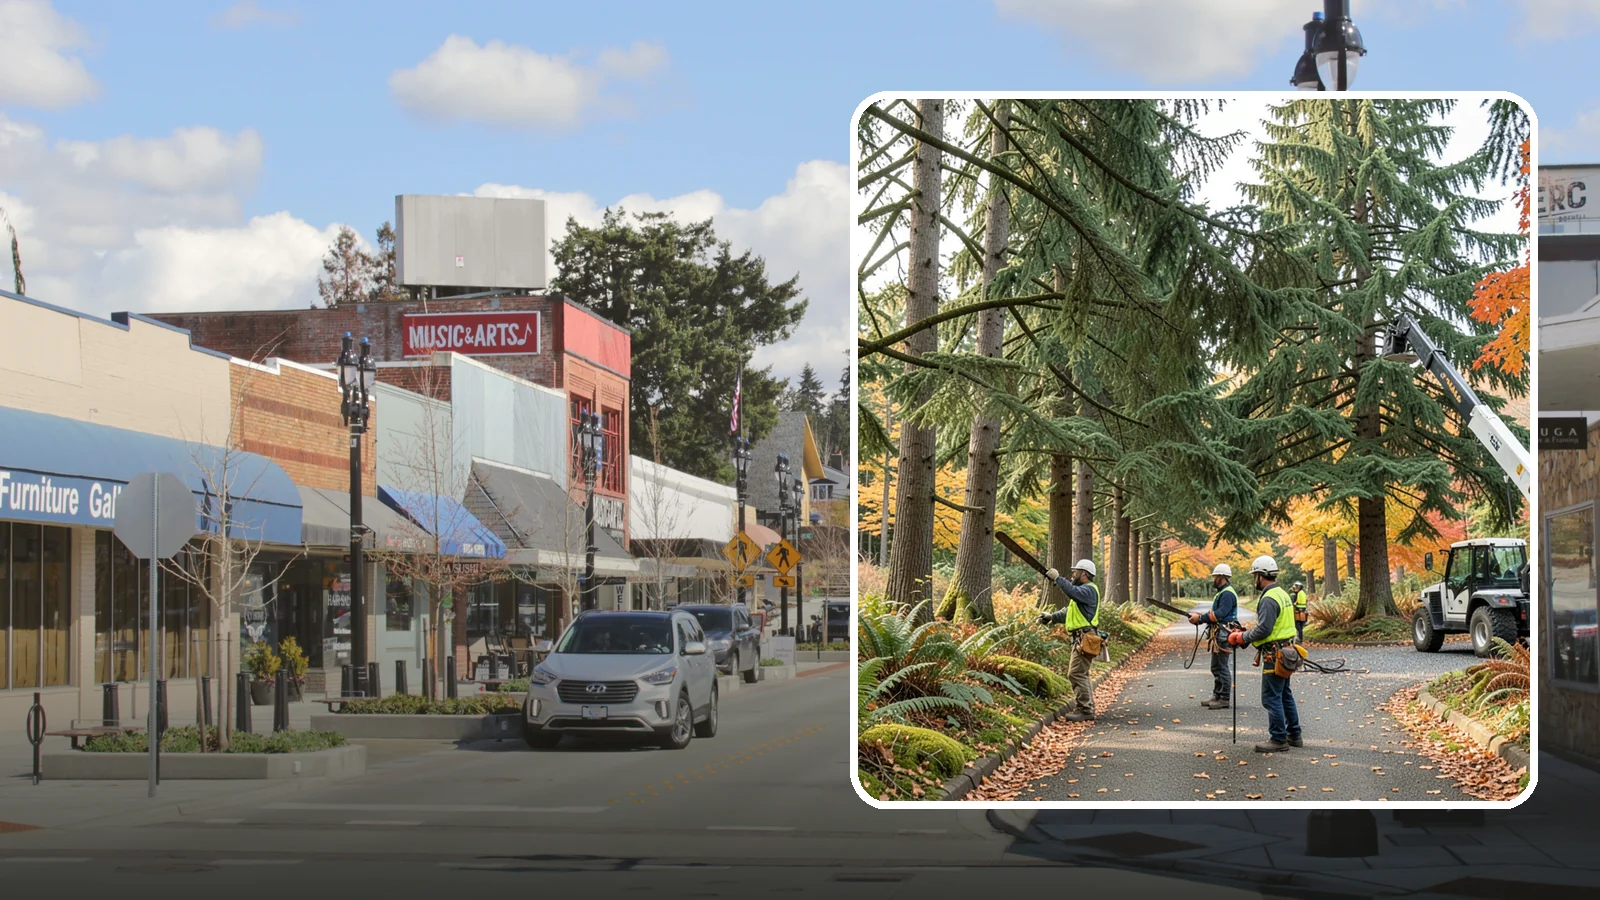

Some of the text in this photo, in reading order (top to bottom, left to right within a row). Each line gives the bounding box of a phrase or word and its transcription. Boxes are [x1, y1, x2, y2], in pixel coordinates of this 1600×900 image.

[0, 471, 122, 520] Furniture Gal
[453, 563, 479, 574] SUSHI
